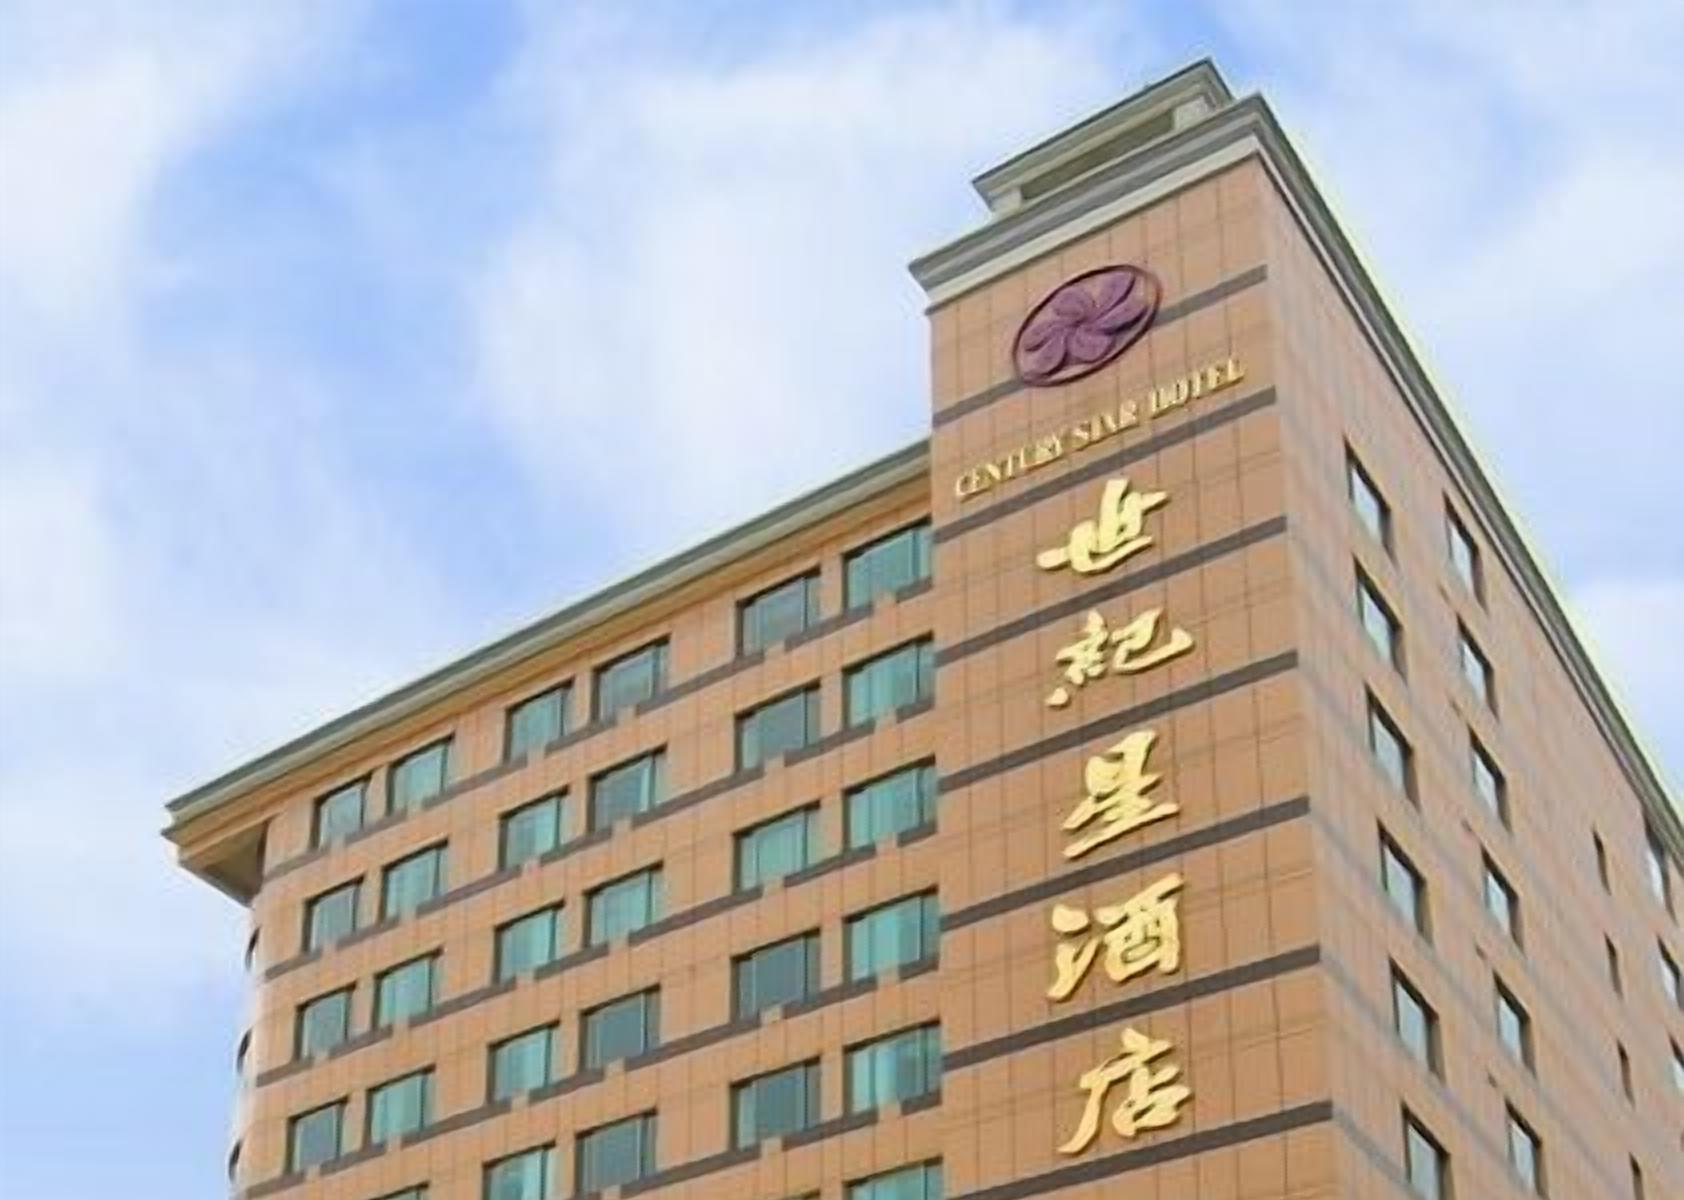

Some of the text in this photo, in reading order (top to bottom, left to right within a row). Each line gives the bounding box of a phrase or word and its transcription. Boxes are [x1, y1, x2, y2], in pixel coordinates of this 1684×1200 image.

[956, 358, 1245, 500] CENTURY STAR HOTEL
